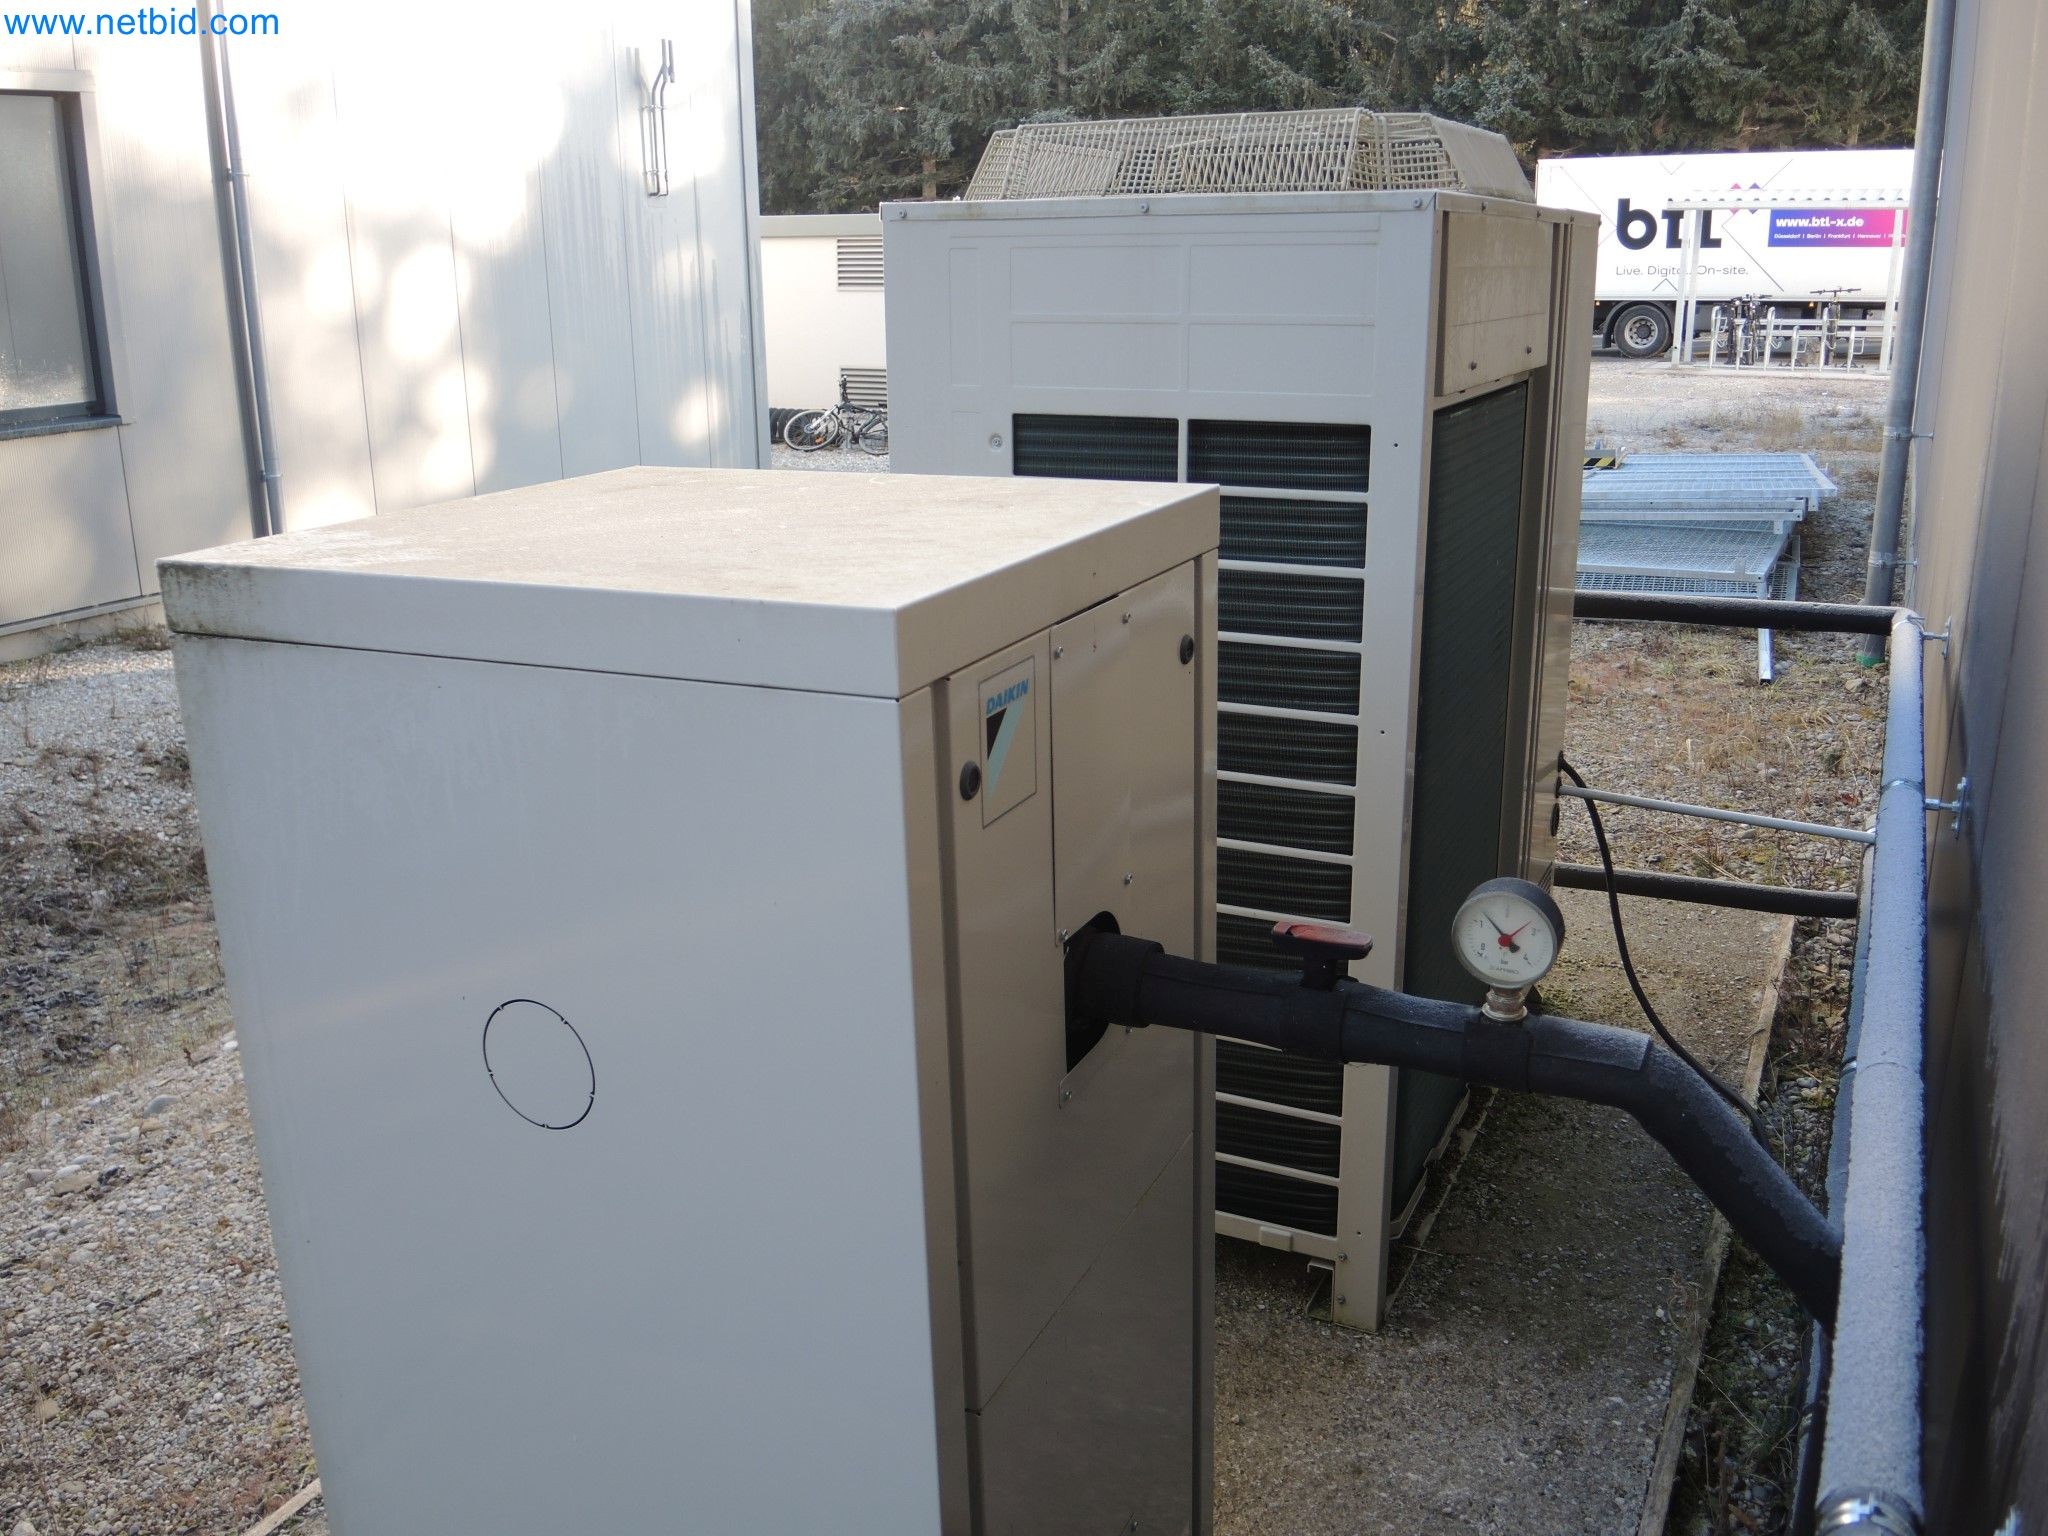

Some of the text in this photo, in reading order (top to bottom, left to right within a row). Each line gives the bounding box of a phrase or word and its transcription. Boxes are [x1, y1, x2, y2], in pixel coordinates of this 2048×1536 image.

[1776, 216, 1865, 228] www.btl-x.de
[1616, 264, 1749, 278] Live. Digit. On-site.
[986, 678, 1029, 714] DAIKIN
